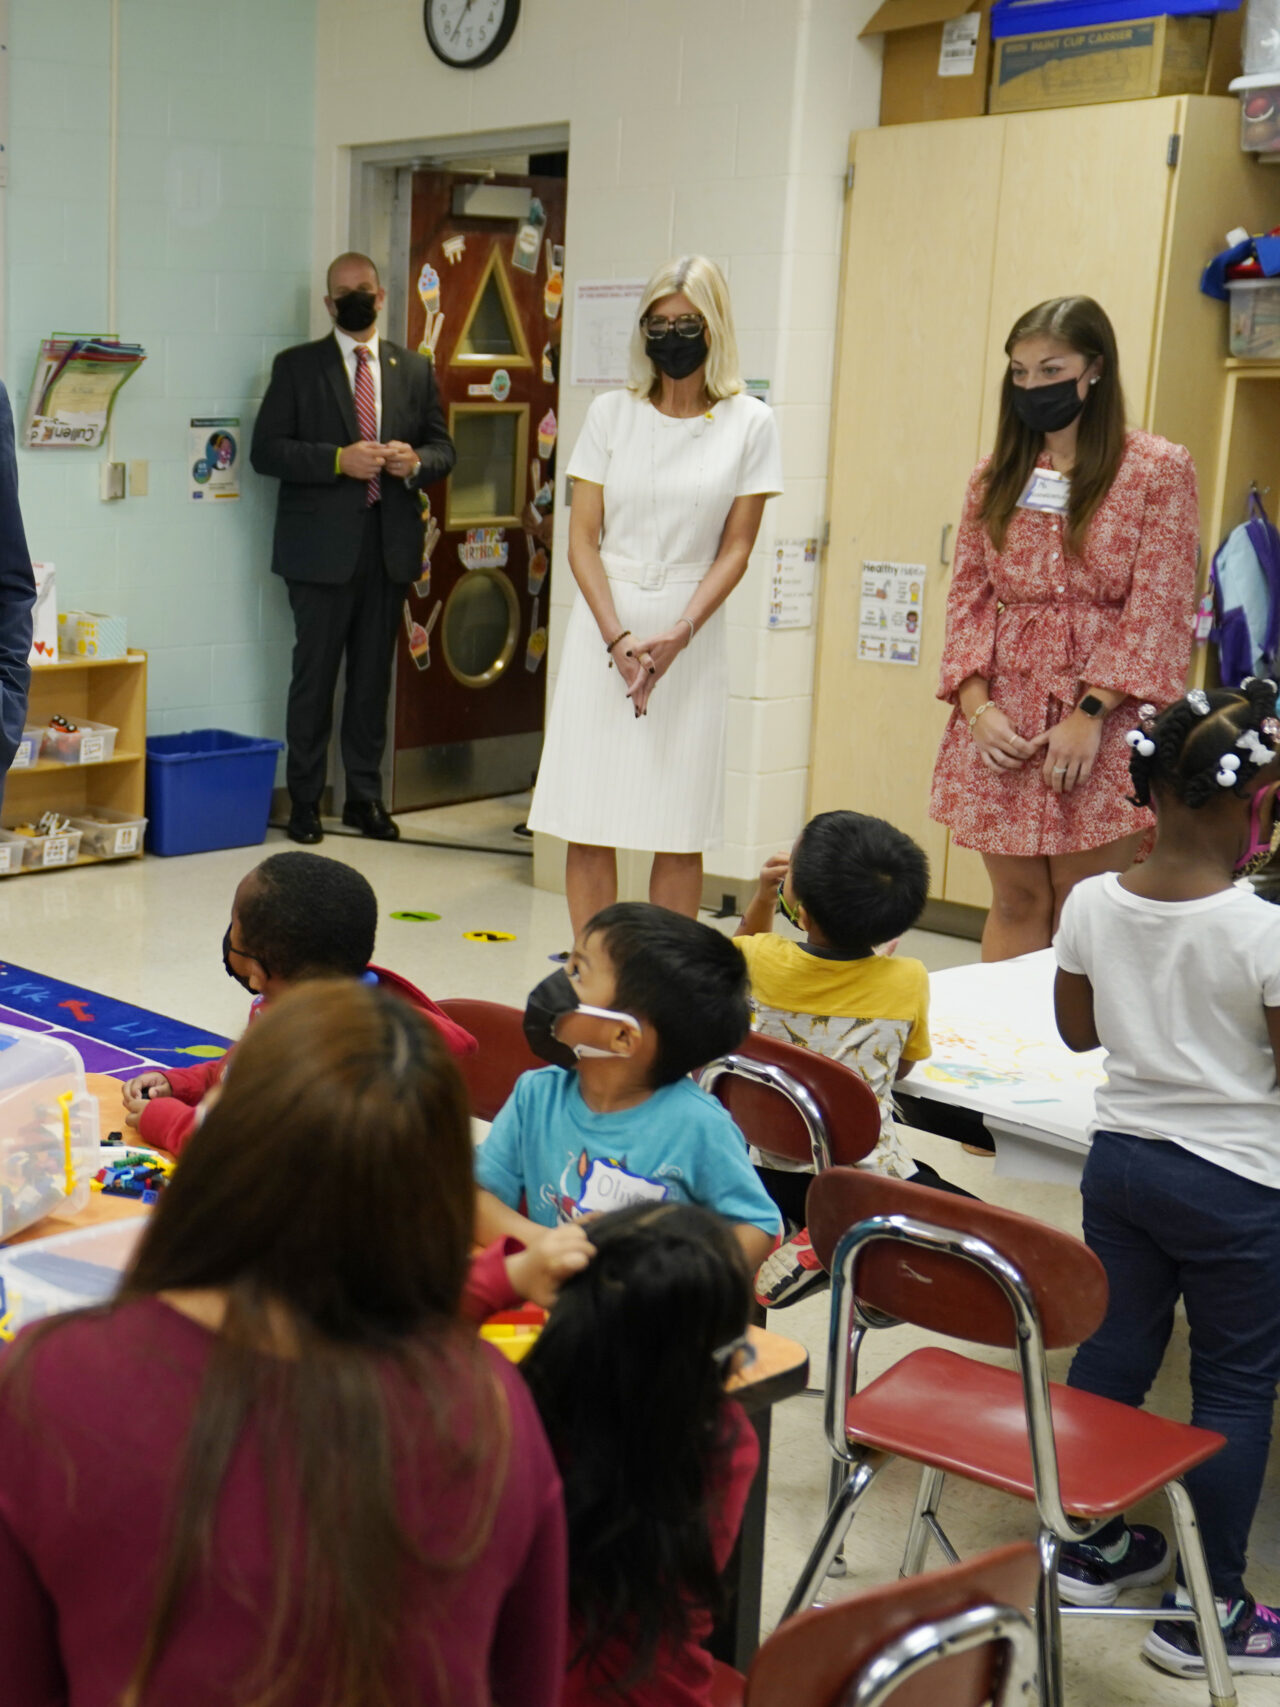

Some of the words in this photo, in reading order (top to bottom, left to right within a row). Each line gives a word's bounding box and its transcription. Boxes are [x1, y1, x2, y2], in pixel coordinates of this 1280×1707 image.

[467, 528, 505, 544] HAPPY
[458, 542, 509, 559] BIRTHDAY
[863, 562, 898, 576] Healthy
